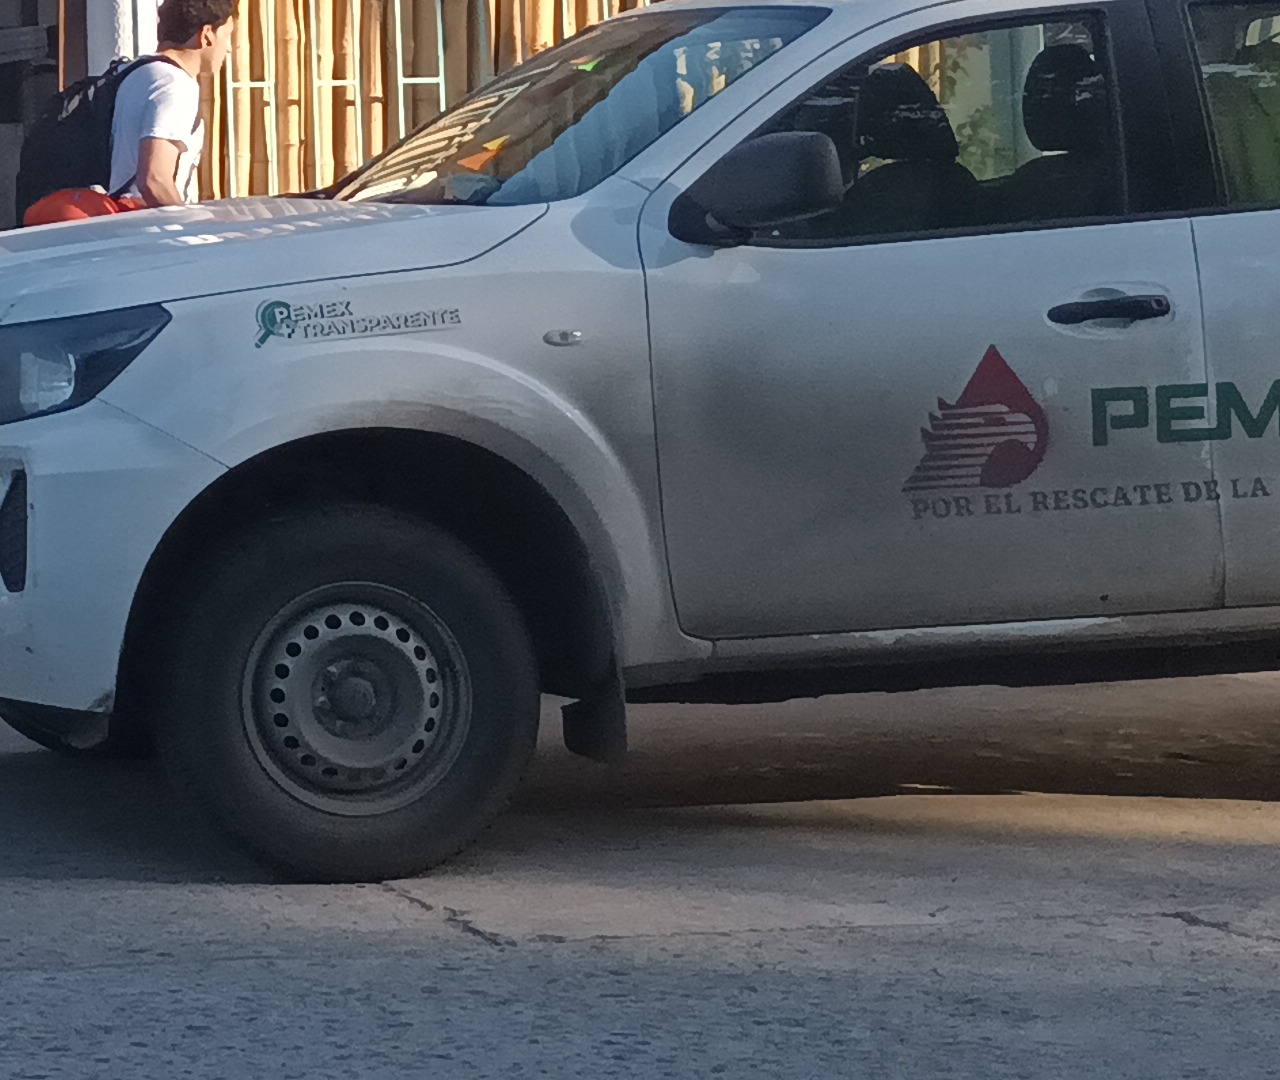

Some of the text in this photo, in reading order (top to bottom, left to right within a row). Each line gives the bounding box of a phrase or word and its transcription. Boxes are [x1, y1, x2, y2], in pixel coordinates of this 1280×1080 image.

[273, 300, 354, 323] PEMEX
[910, 476, 1272, 521] POR EL RESCATE DE LA
